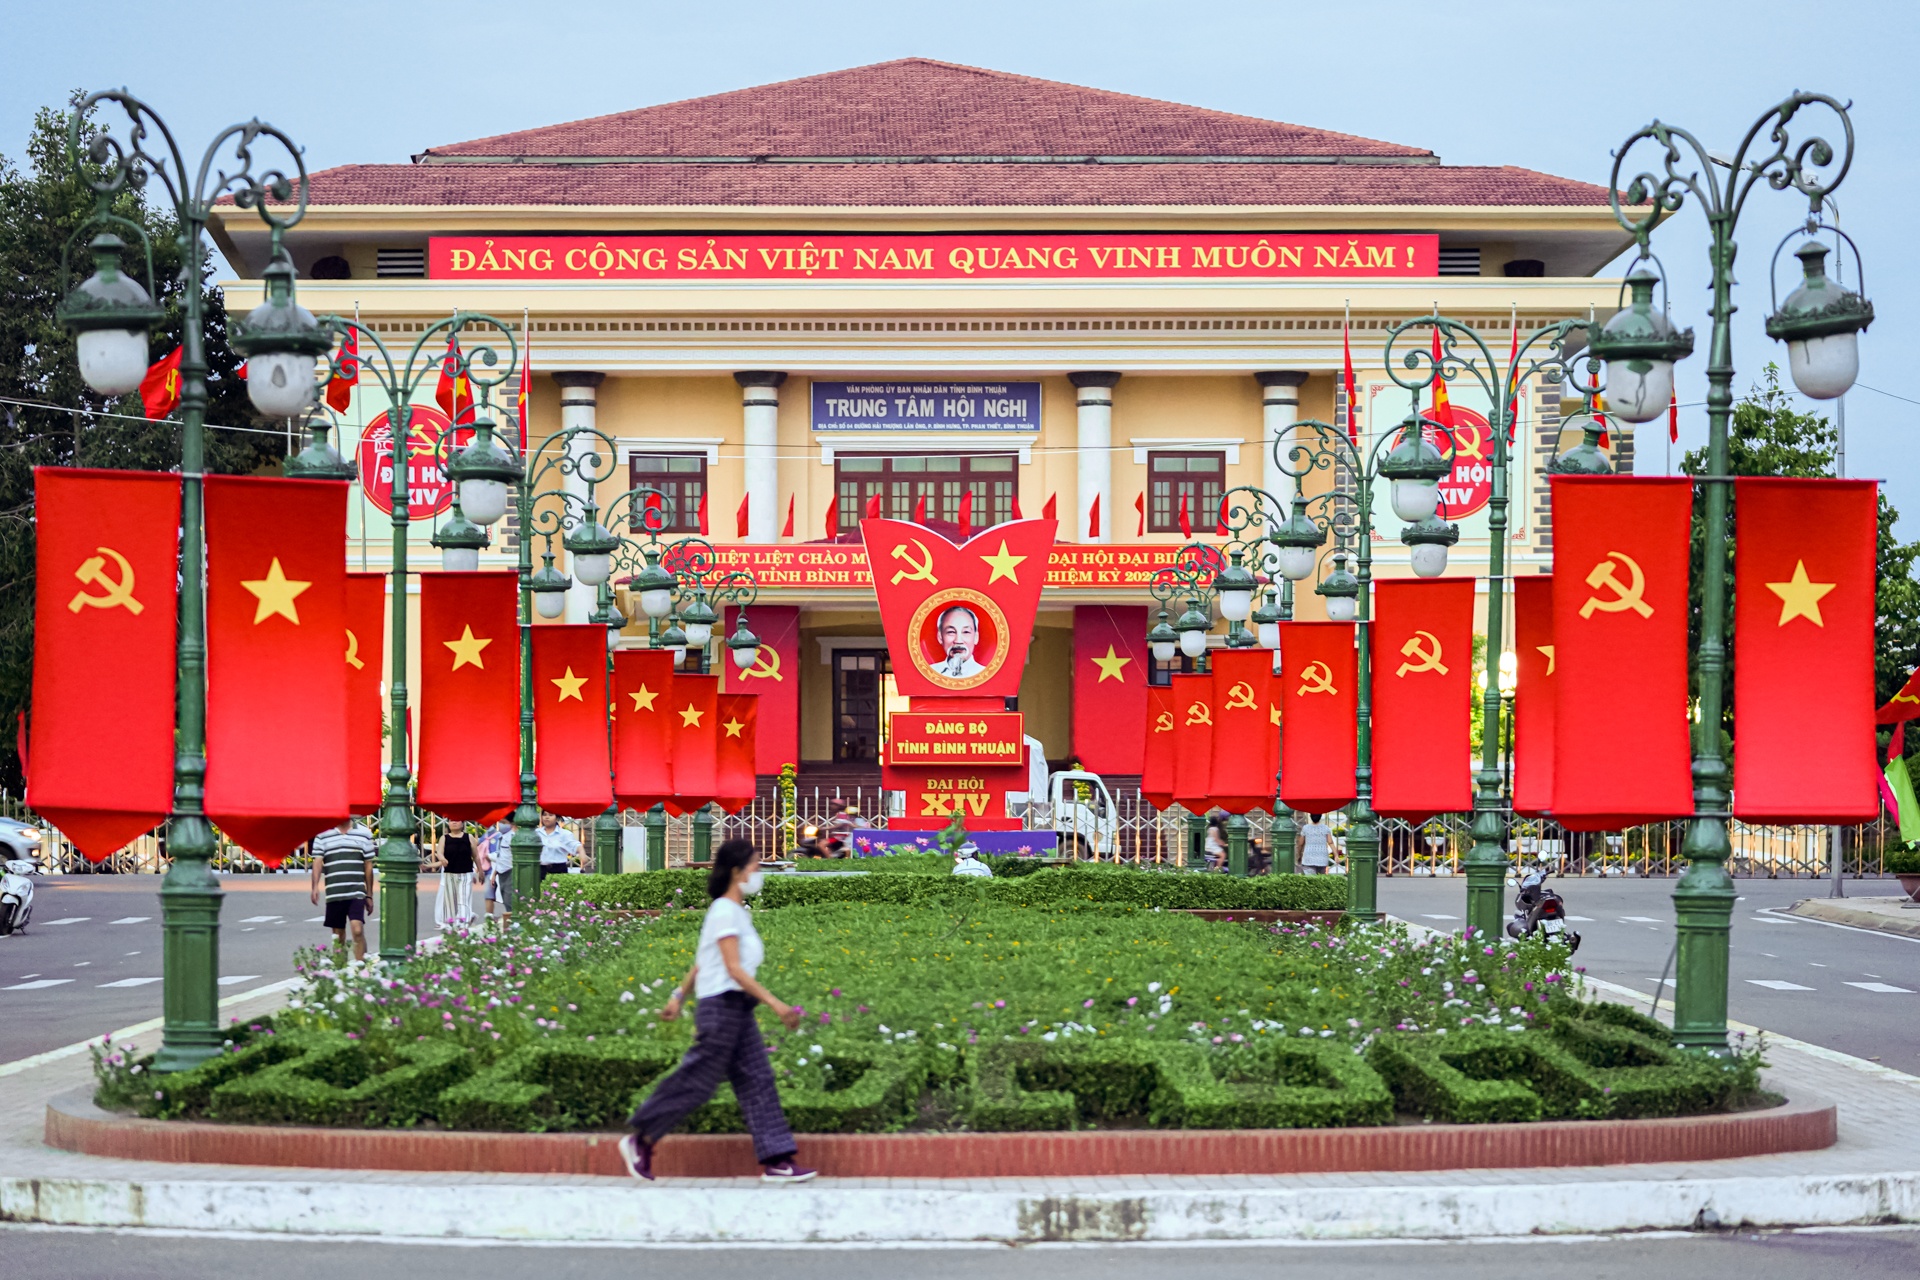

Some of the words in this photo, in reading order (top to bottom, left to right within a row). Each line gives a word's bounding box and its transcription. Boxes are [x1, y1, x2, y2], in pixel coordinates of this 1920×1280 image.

[450, 240, 555, 272] ĐẢNG
[564, 241, 668, 277] CỘNG
[677, 239, 748, 271] SẢN
[758, 241, 844, 276] VIỆT
[853, 248, 935, 271] NAM
[948, 247, 1079, 275] QUANG
[1087, 246, 1182, 269] VINH
[1192, 239, 1302, 269] MUÔN
[1313, 239, 1396, 268] NĂM
[861, 384, 884, 393] PHÒNG
[825, 398, 887, 418] TRUNG
[895, 395, 935, 417] TÂM
[943, 395, 975, 422] HỘI
[984, 398, 1027, 421] NGHỊ
[380, 466, 415, 484] ĐI
[1456, 462, 1492, 487] HỘI
[754, 549, 795, 567] LIỆT
[798, 549, 847, 564] CHÀO
[1048, 552, 1078, 567] ĐẠI
[1082, 549, 1114, 567] HỘI
[1118, 552, 1149, 567] ĐẠI
[758, 566, 801, 582] TỈNH
[806, 567, 850, 582] BÌNH
[1043, 567, 1093, 585] HIỆM
[1097, 567, 1121, 582] KỲ
[925, 719, 965, 734] ĐẢNG
[969, 720, 988, 737] BỘ
[897, 739, 929, 754] TỈNH
[933, 740, 967, 754] BÌNH
[970, 740, 1016, 757] THUẬN
[927, 779, 953, 793] ĐẠI
[957, 775, 985, 793] HỘI
[920, 793, 991, 816] XIV
